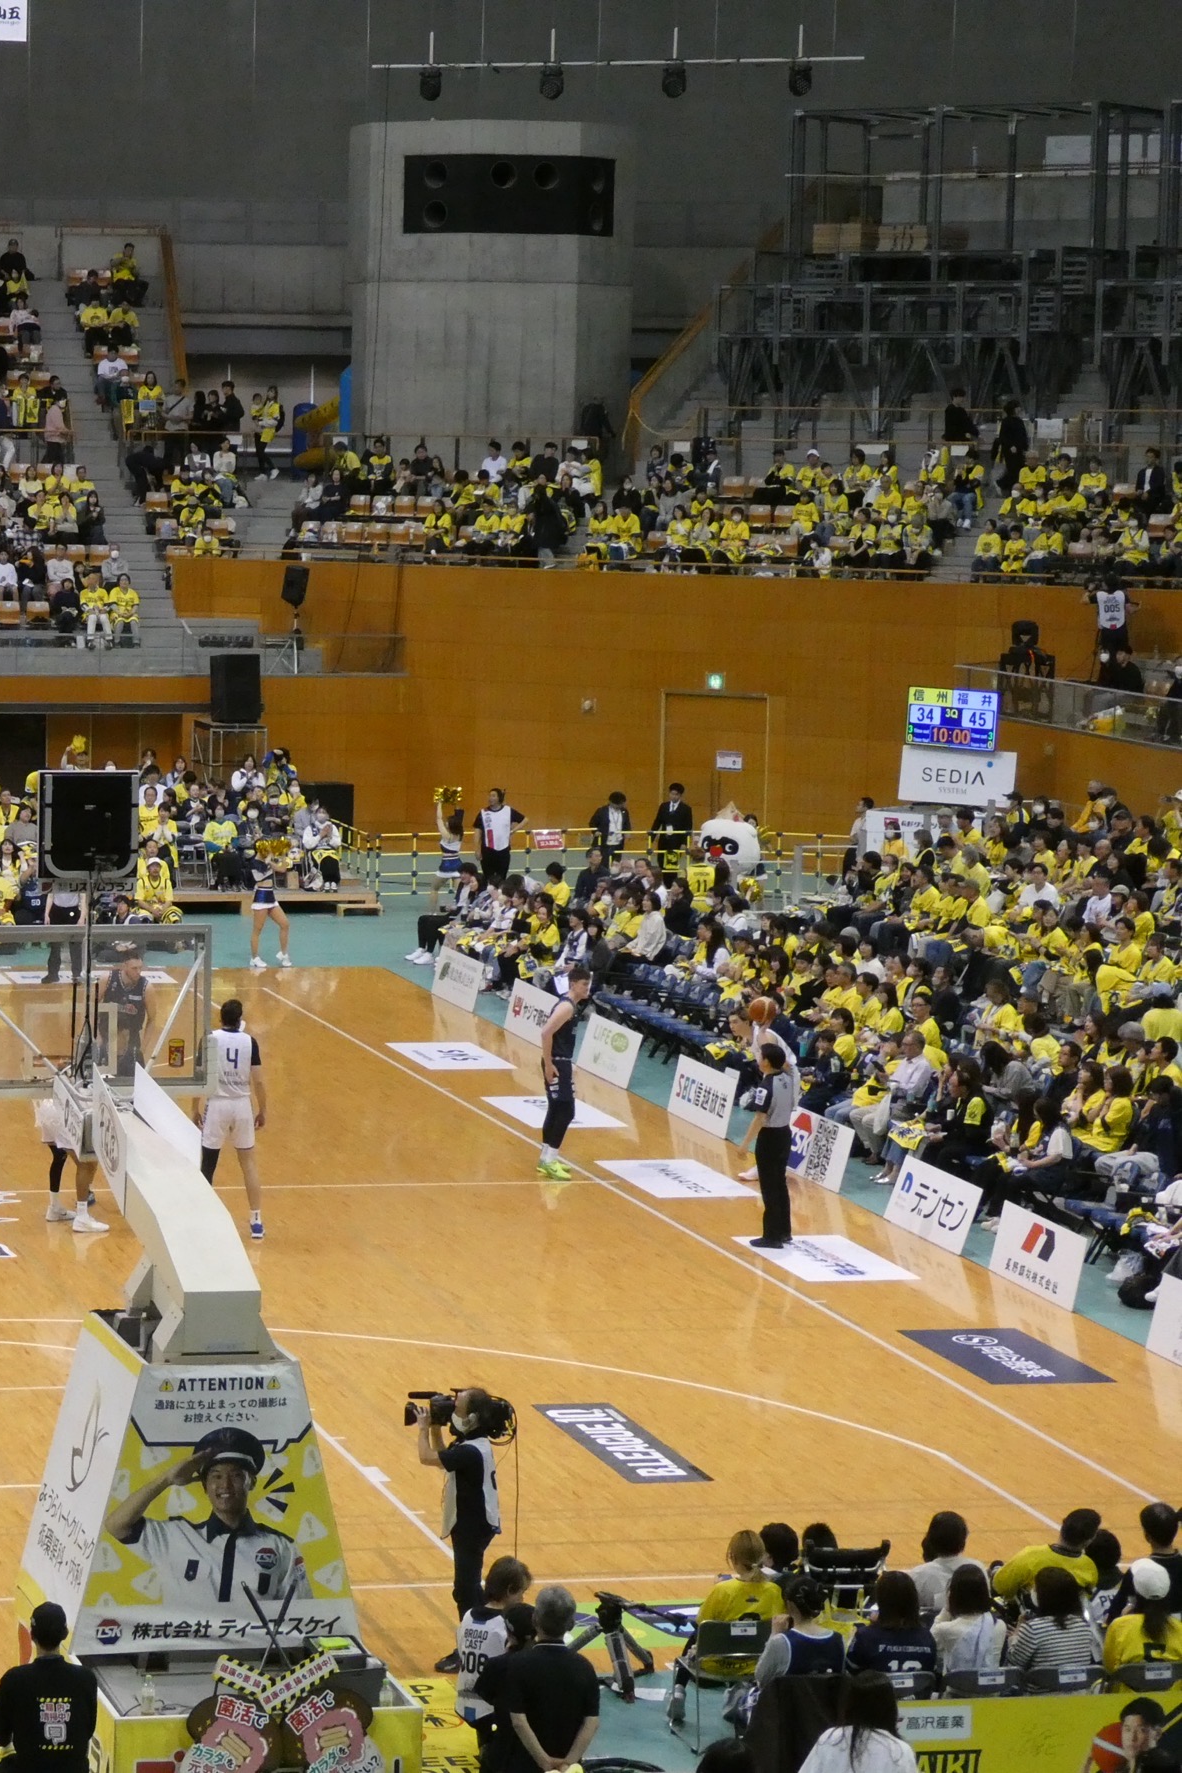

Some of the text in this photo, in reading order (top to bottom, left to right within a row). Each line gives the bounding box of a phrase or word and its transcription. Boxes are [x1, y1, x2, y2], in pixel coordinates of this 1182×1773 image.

[917, 707, 986, 727] 34 3Q 45
[933, 727, 971, 744] 10:00
[938, 787, 967, 795] SYSTEM
[226, 1047, 238, 1069] 4
[177, 1377, 264, 1392] ATTENTION
[154, 1398, 287, 1410] 通路に立ち止まっての撮影は
[184, 1413, 259, 1423] お控えください。
[575, 1420, 688, 1477] B.LEAGUE
[132, 1616, 341, 1640] 株式会社 ティーエスケイ
[464, 1629, 488, 1640] BROAD
[465, 1639, 483, 1650] CAST
[218, 1696, 268, 1727] 菌活で
[288, 1691, 333, 1733] 菌活で
[906, 1715, 965, 1730] 高沢産業
[192, 1745, 235, 1770] カラダを
